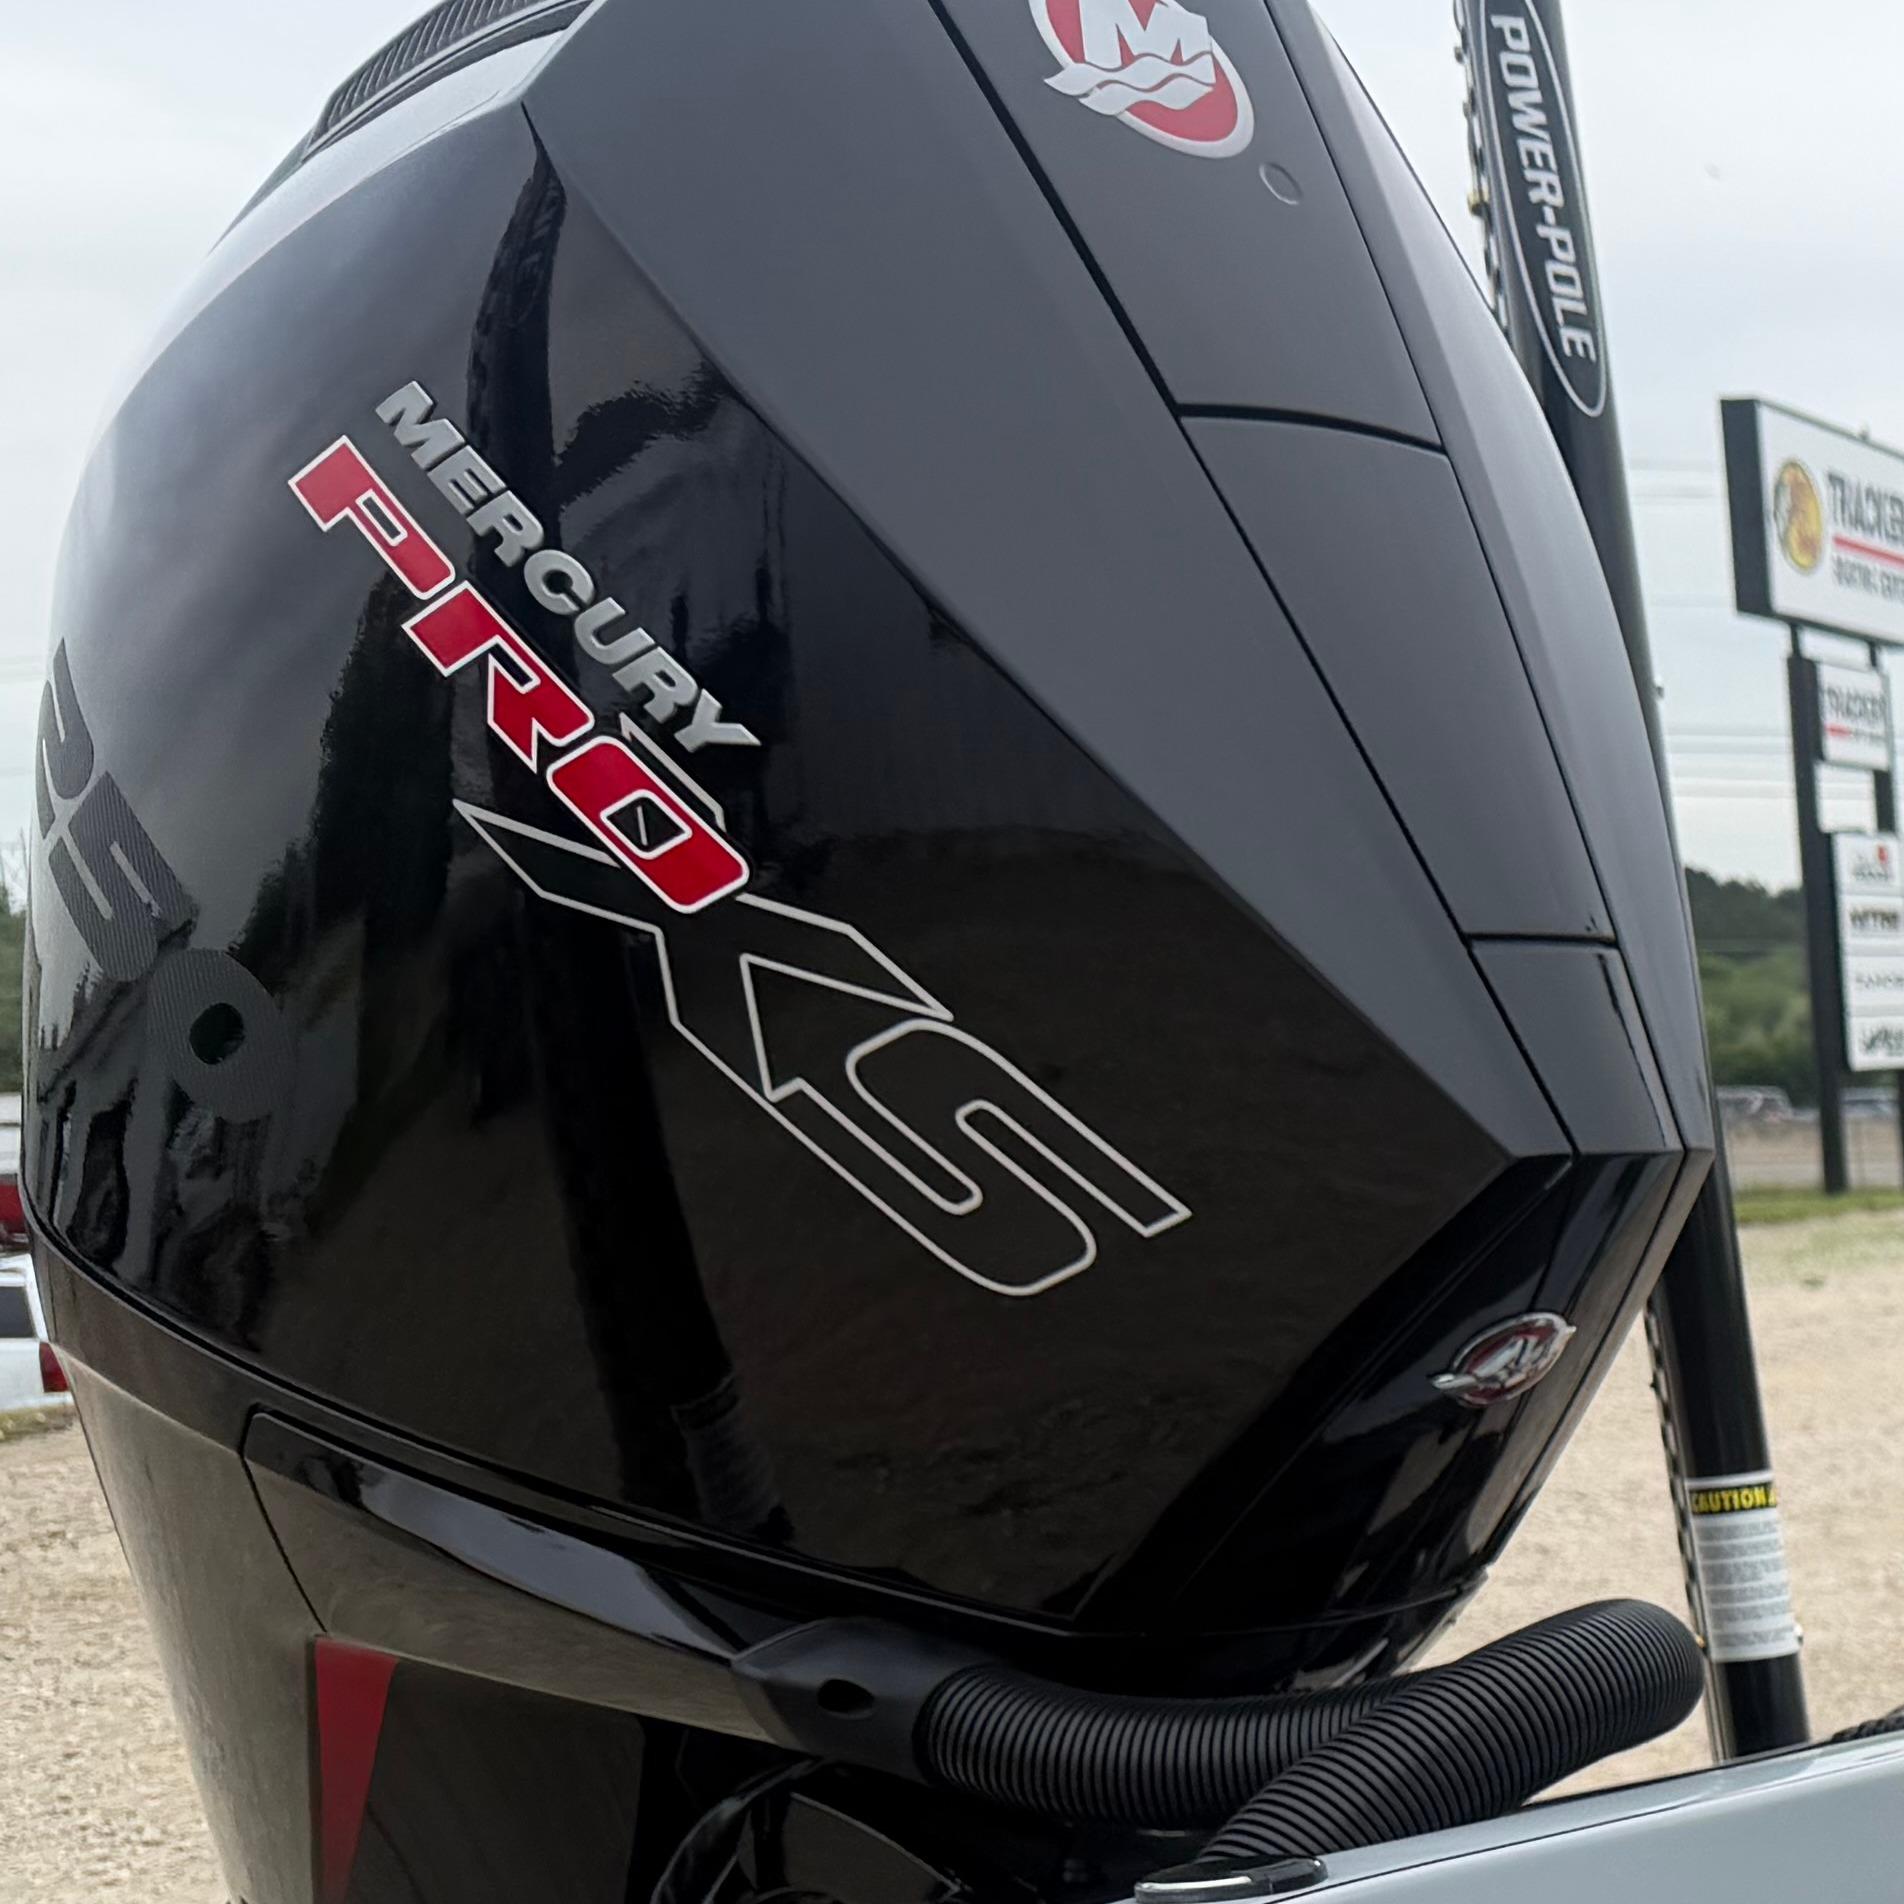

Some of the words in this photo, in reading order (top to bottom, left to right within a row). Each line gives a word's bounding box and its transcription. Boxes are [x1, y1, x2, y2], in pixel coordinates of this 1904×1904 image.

[1490, 14, 1597, 364] POWER-POLE
[288, 435, 750, 912] PRO
[375, 380, 762, 755] MERCURY
[36, 636, 298, 1122] 250
[452, 713, 1193, 1297] XS
[1692, 1487, 1767, 1512] CAUTION
